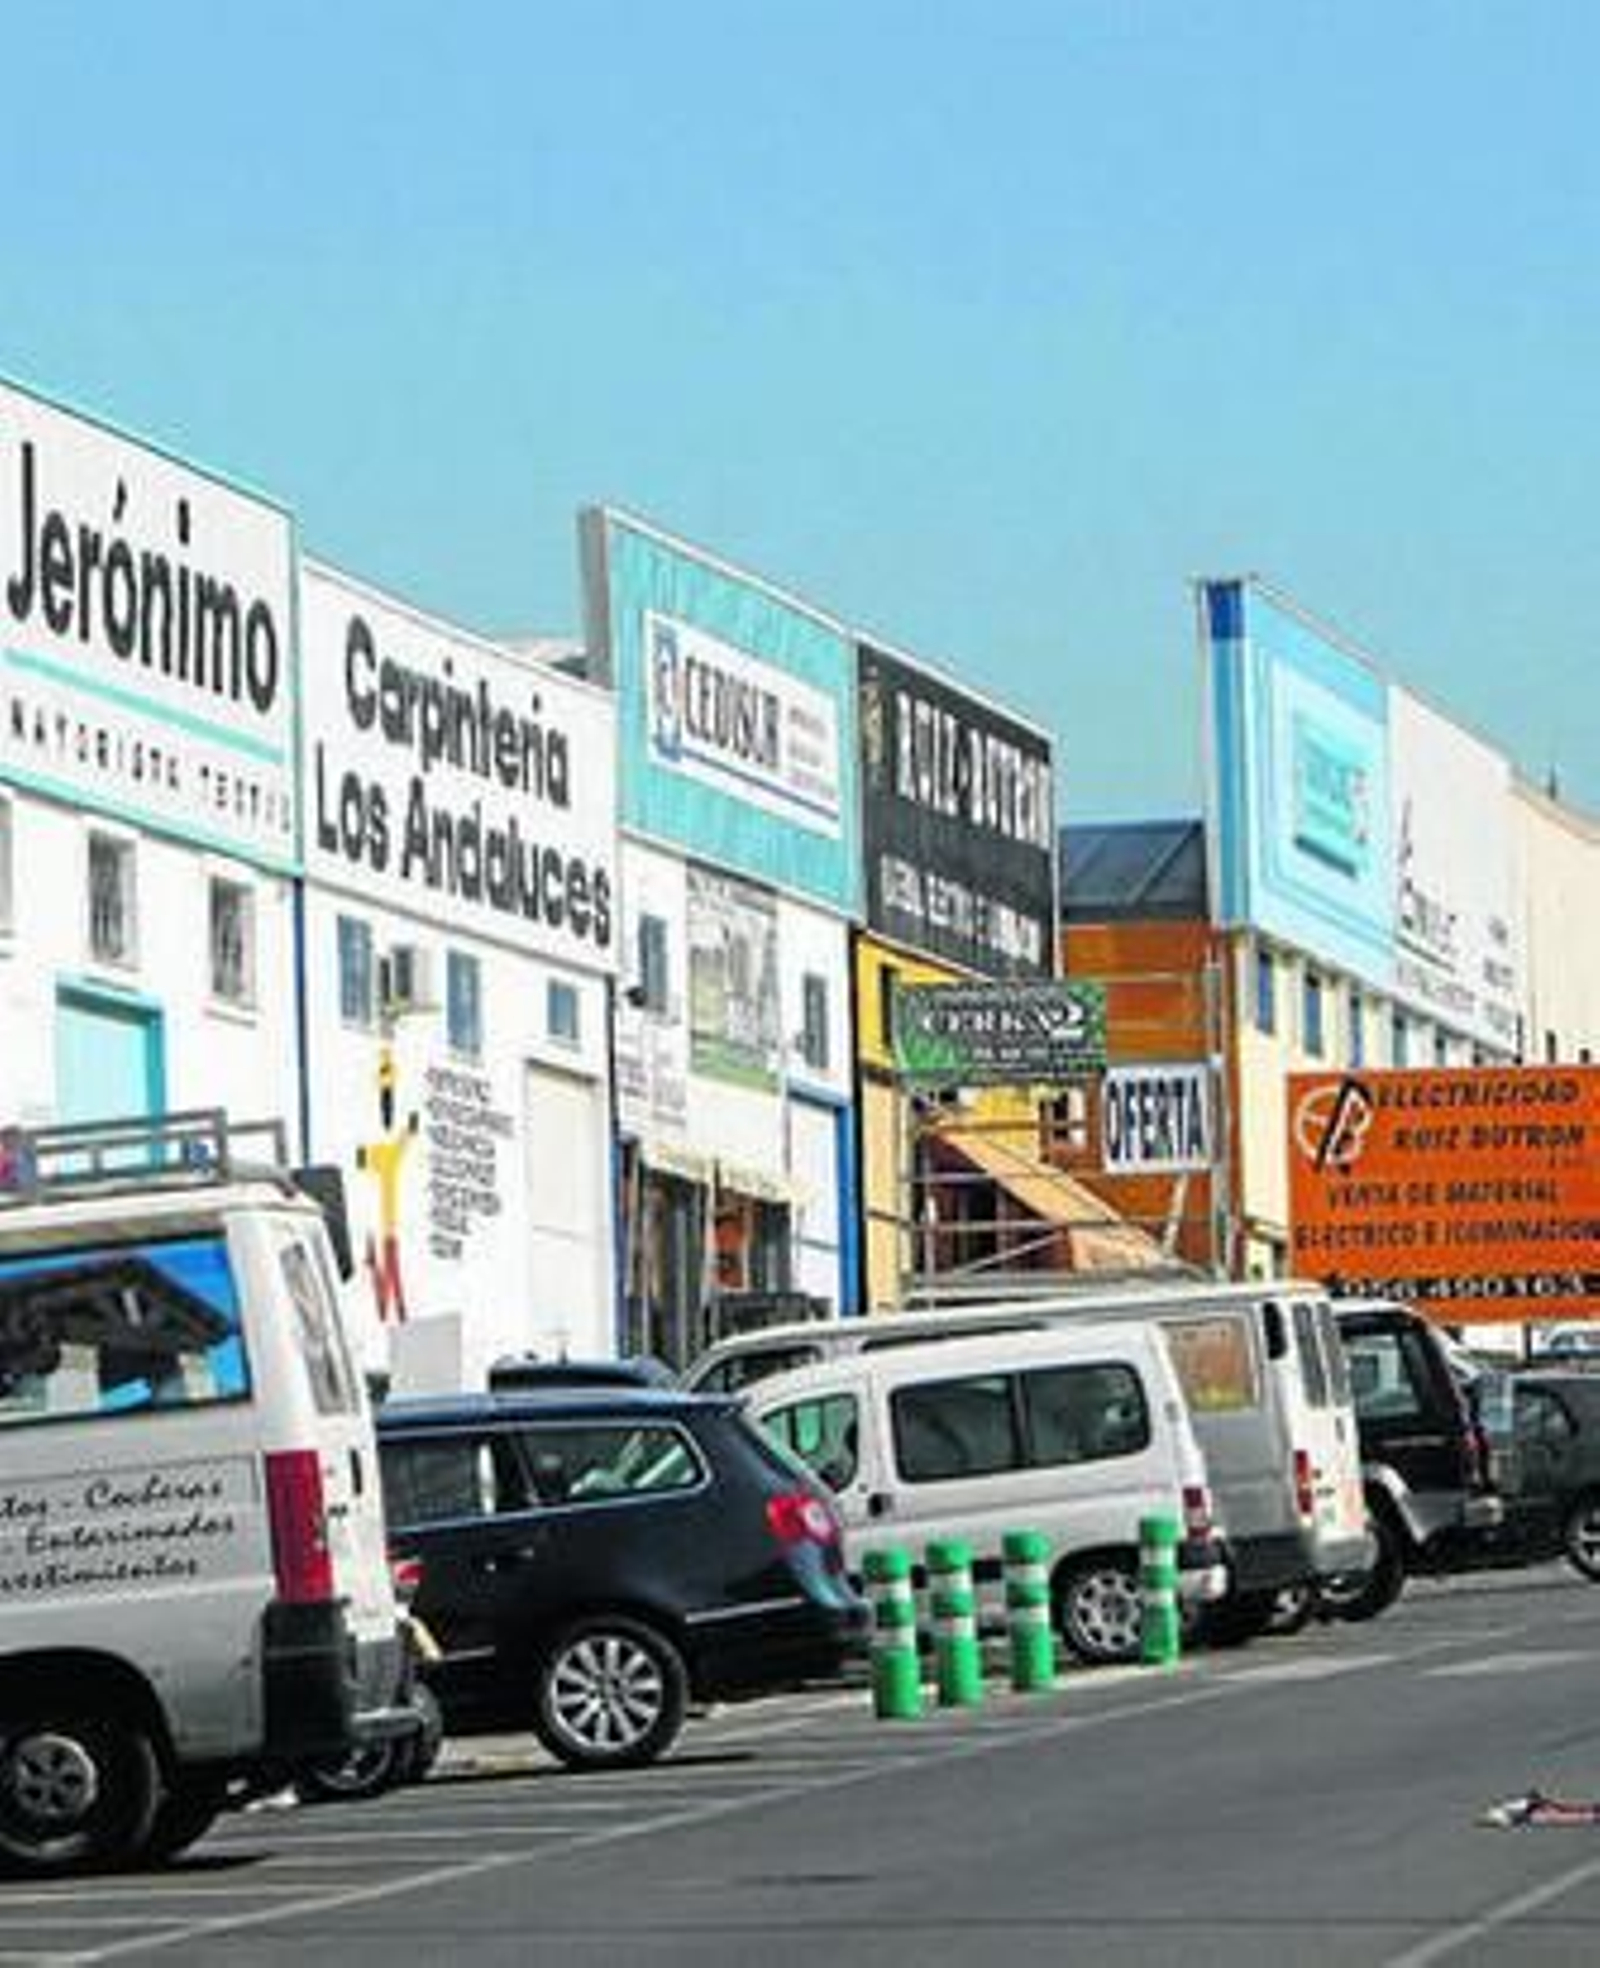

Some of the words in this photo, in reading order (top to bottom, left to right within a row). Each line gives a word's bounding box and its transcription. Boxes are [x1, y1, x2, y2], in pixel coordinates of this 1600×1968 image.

[8, 441, 278, 714] Jerónimo
[318, 741, 389, 872] Los
[402, 777, 611, 947] Andaluces
[1377, 1080, 1580, 1107] ELECTRICIDAD
[1105, 1077, 1205, 1161] OFERTA
[1408, 1182, 1435, 1206] DE
[1447, 1178, 1557, 1203] MATERIAL
[0, 1495, 47, 1517] tos
[85, 1475, 221, 1508] Cocheras
[27, 1512, 234, 1554] Entarimados
